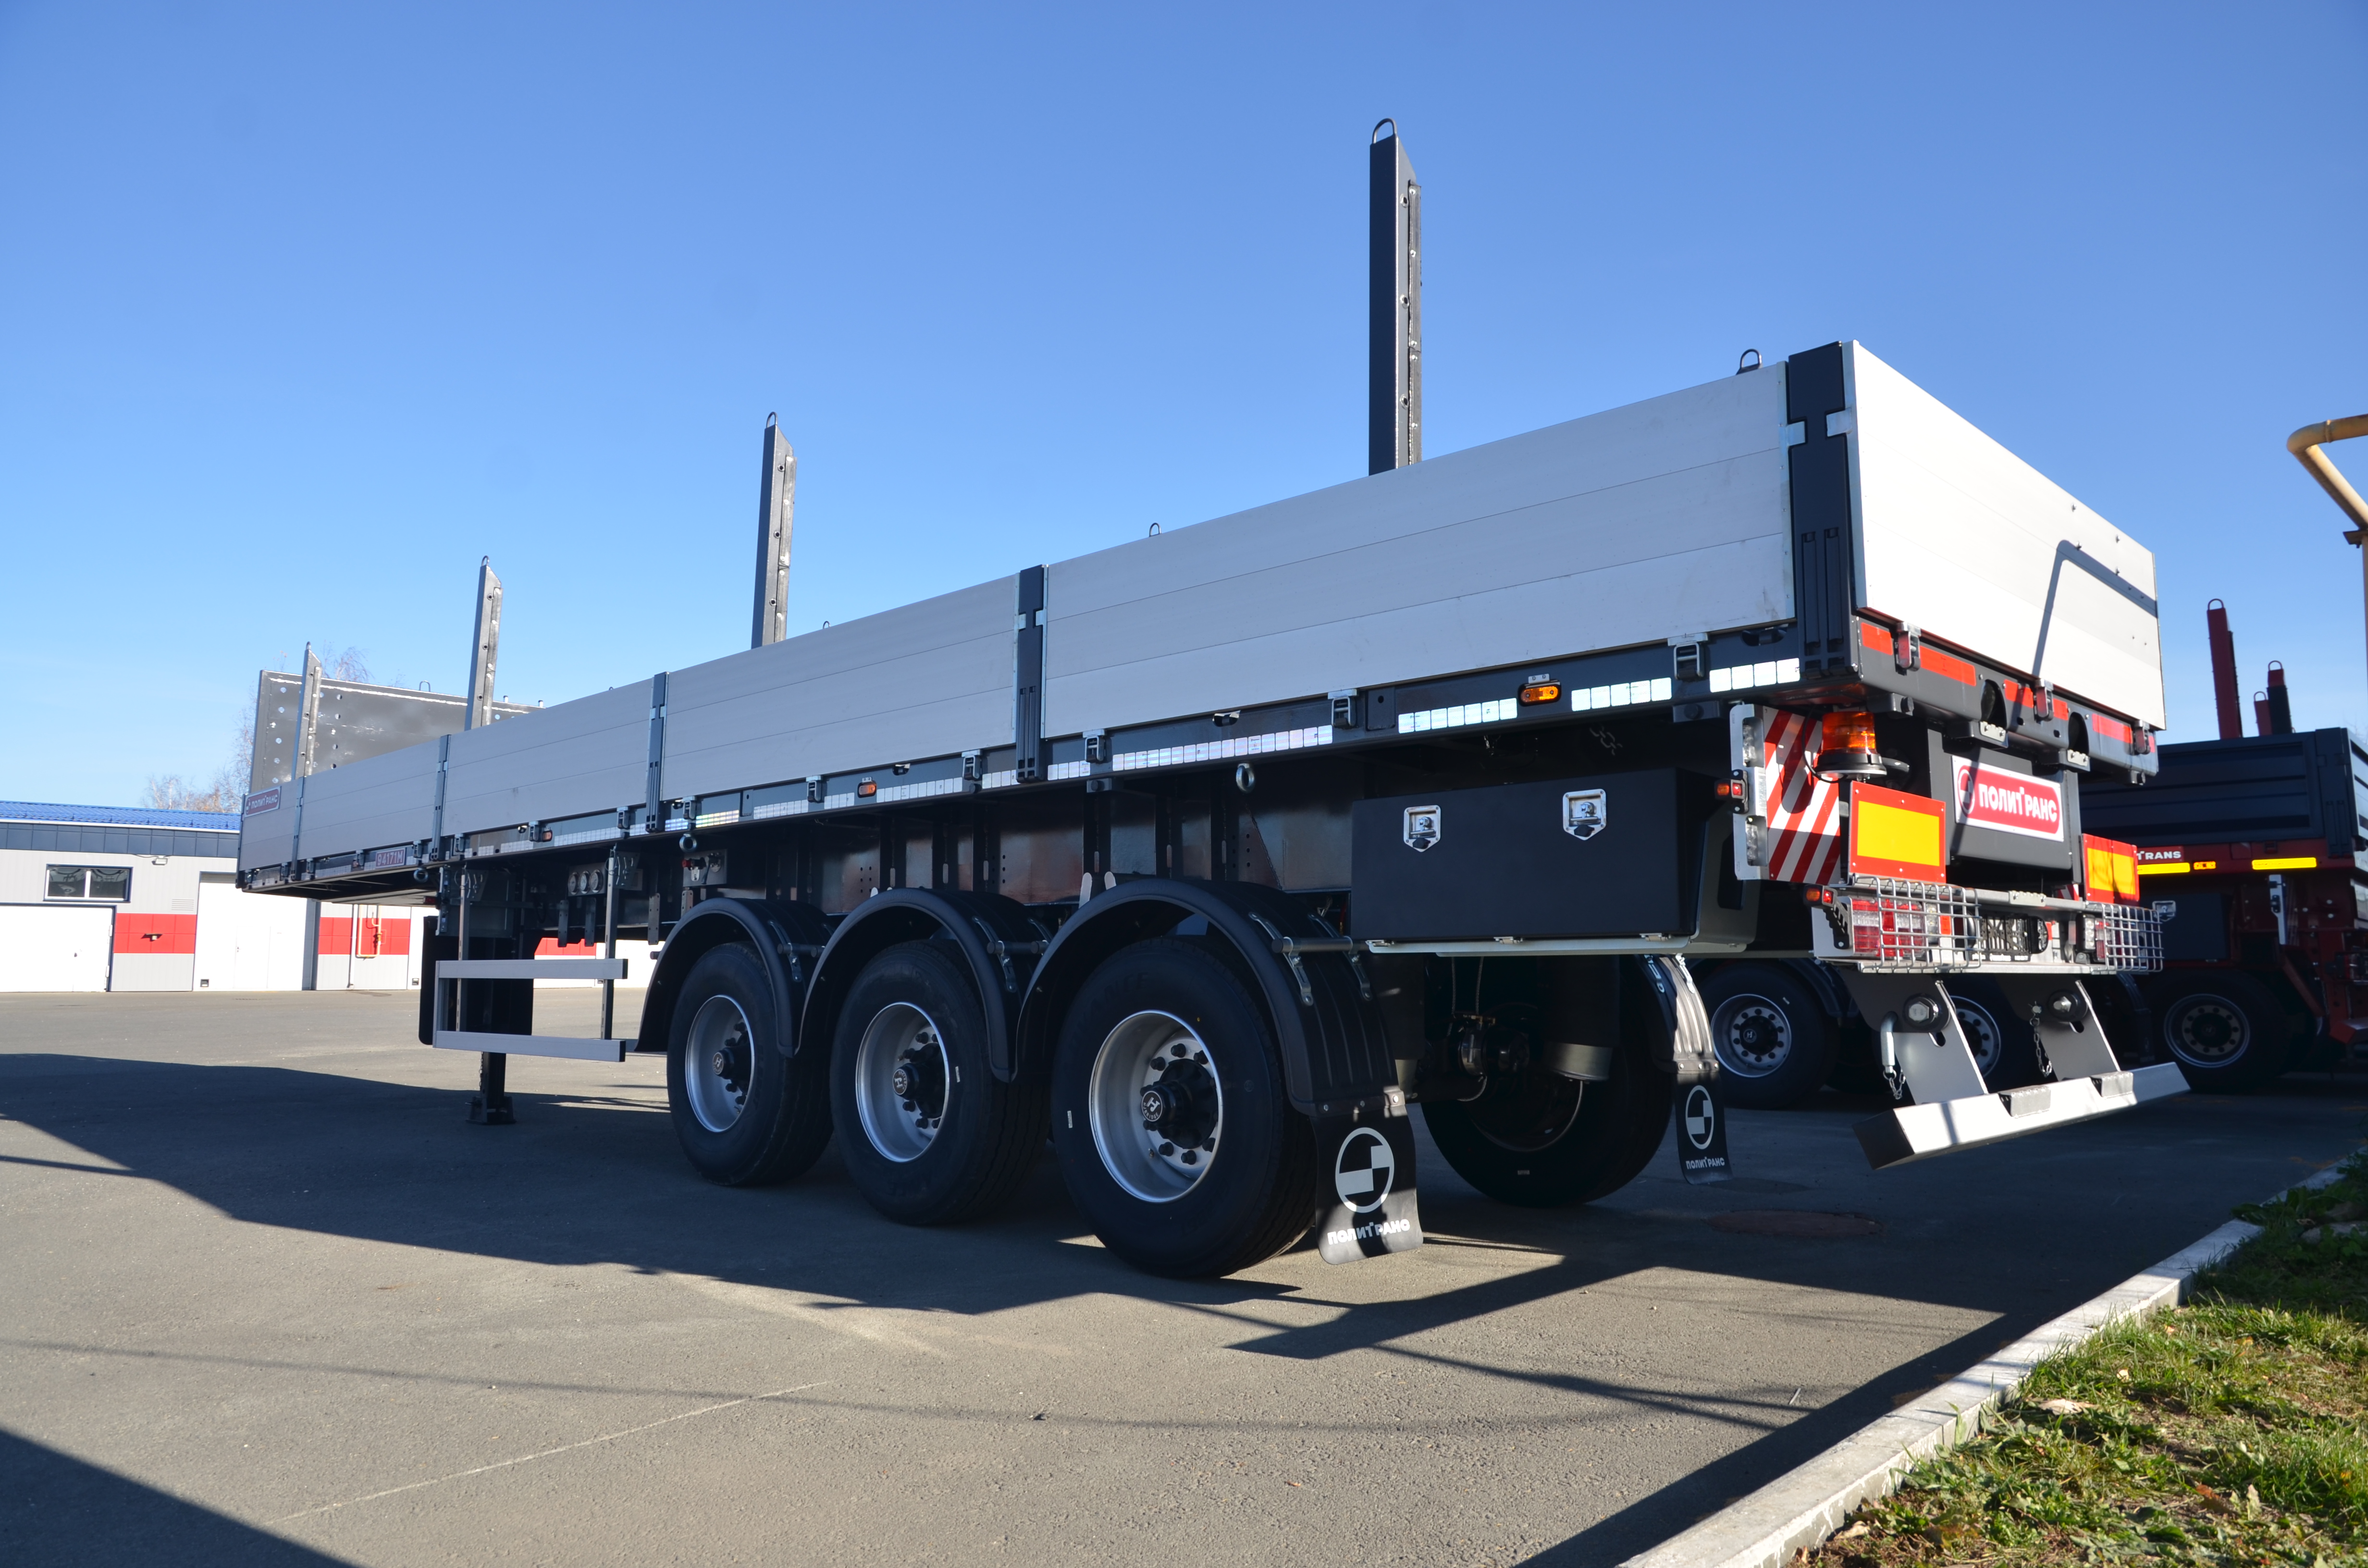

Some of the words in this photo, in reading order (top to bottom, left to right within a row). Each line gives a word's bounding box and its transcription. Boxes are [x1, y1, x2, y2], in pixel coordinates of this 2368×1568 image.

[251, 794, 278, 809] ПОЛИТРАНС
[1978, 783, 2057, 822] ПОЛИТРАНС
[1686, 1156, 1725, 1169] ПОЛИТРАНС
[1327, 1219, 1410, 1245] ПОЛИТРАНС
